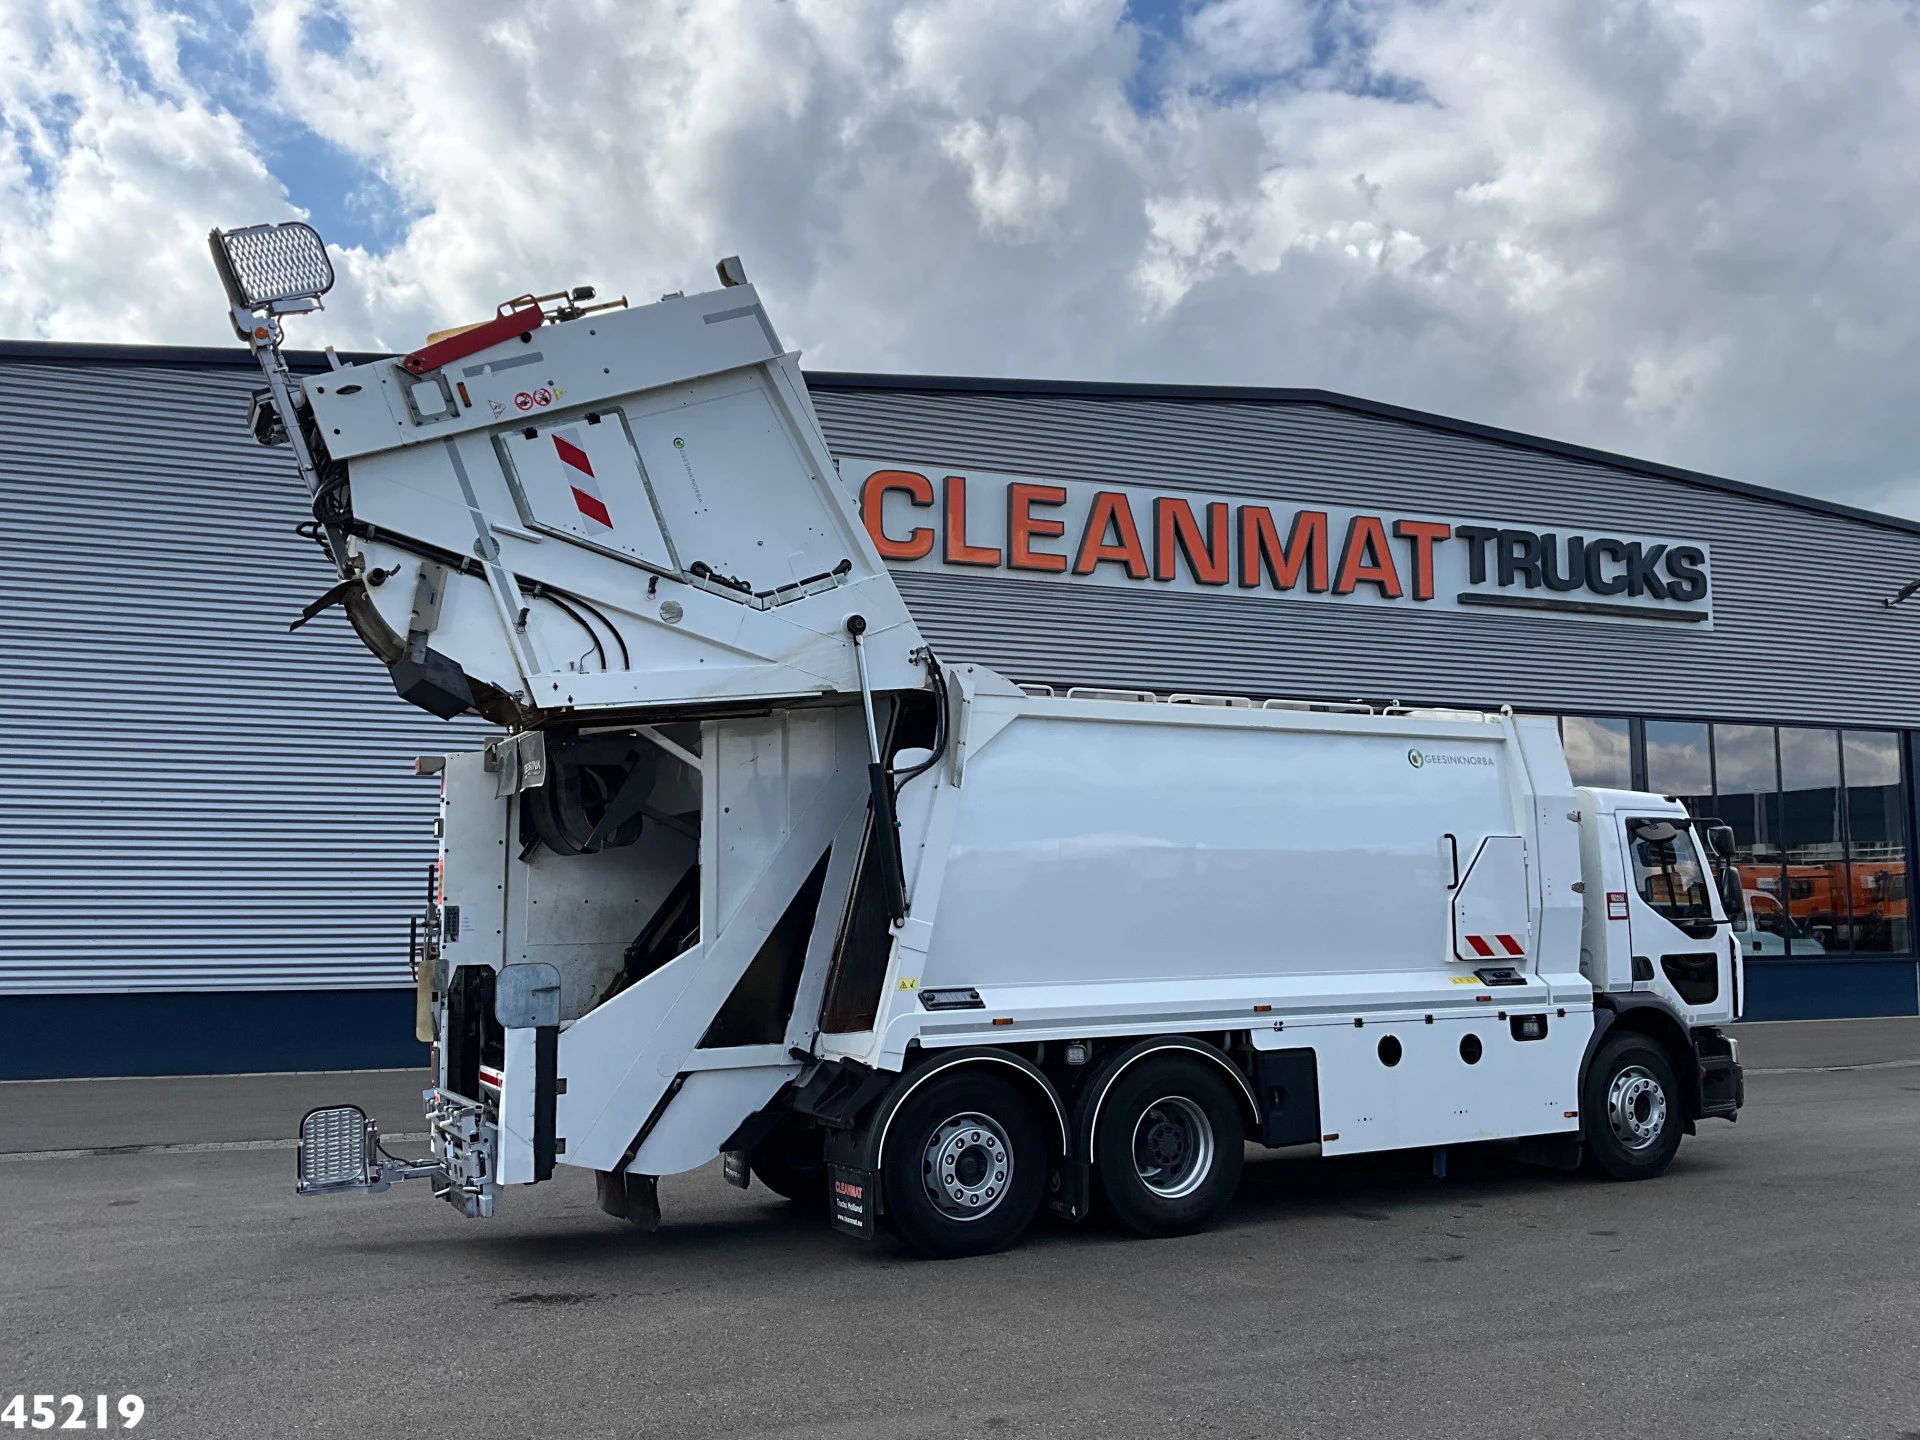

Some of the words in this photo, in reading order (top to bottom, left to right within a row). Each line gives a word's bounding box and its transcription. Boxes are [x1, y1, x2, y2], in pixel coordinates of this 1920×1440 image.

[859, 469, 1450, 601] CLEANMAT
[1455, 525, 1708, 601] TRUCKS
[1424, 754, 1494, 766] GEESINKNORBA
[835, 1181, 863, 1199] CLEANMAT
